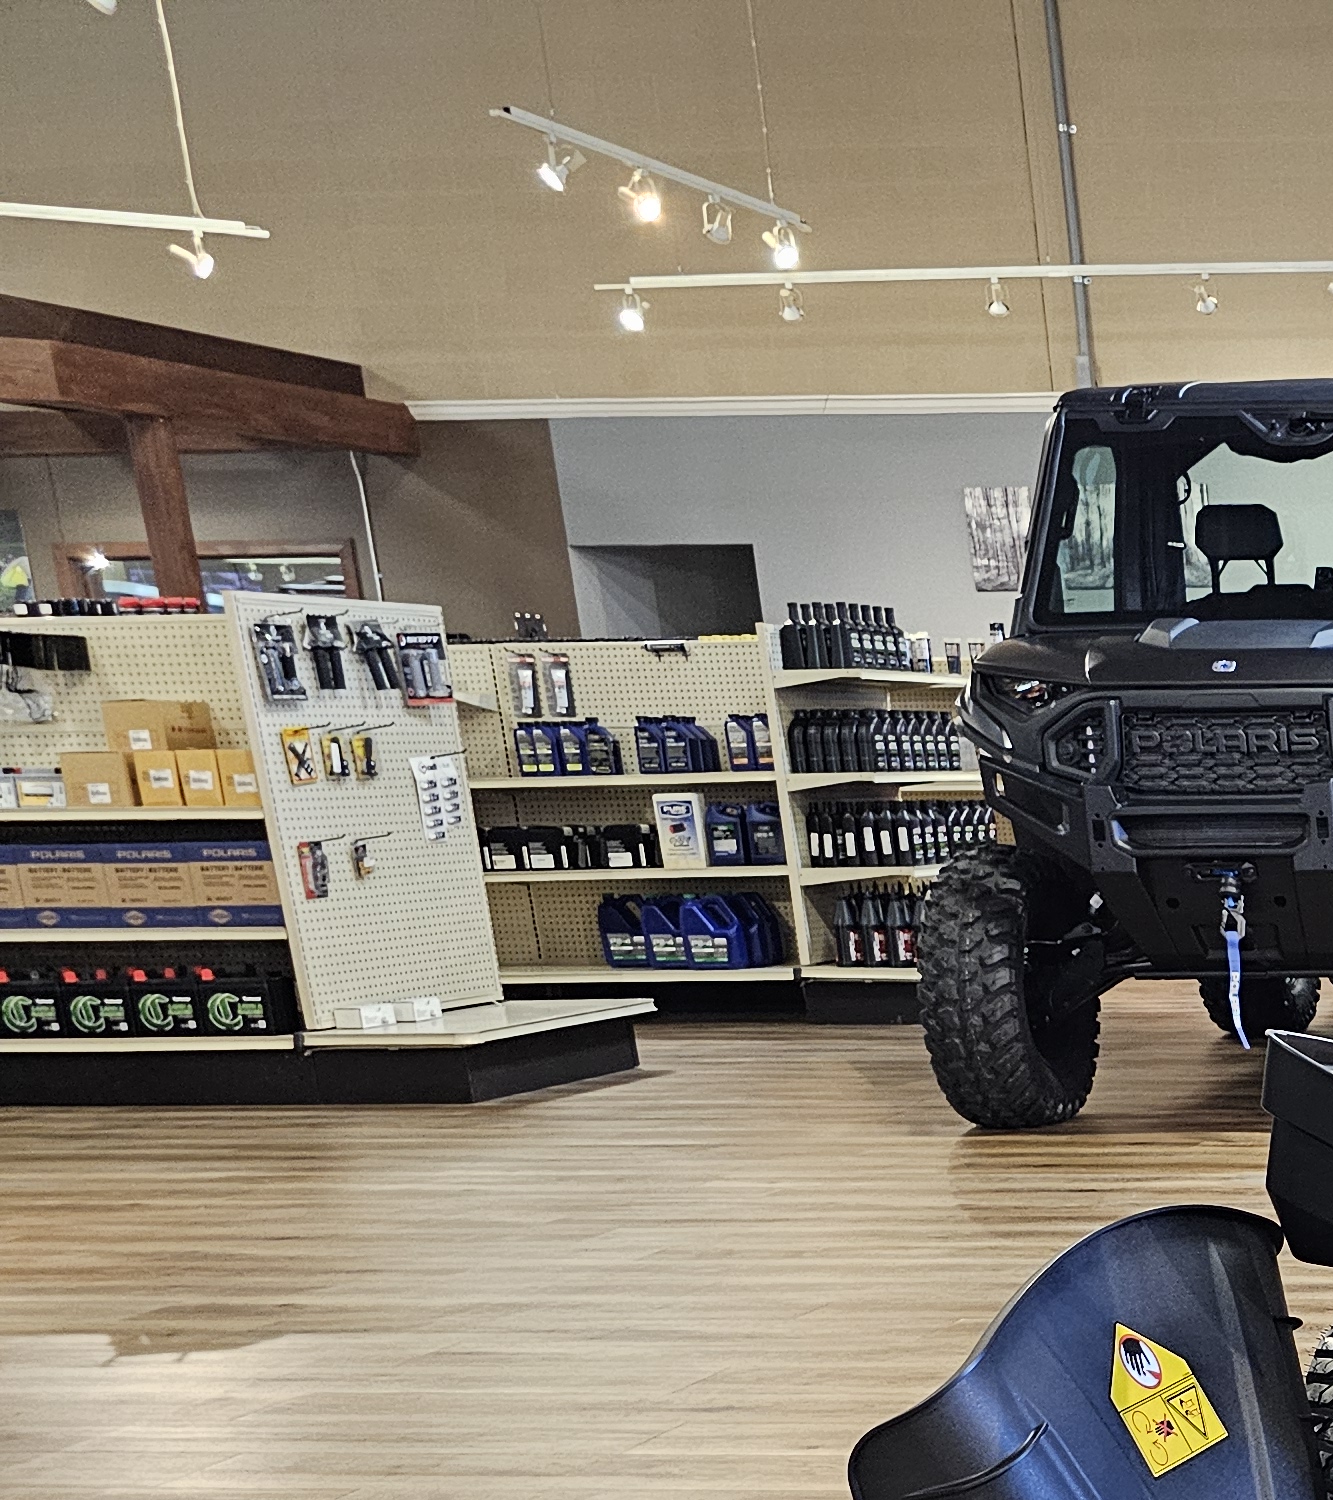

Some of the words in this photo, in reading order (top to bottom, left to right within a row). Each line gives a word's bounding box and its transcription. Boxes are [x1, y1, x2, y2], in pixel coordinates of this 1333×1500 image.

[1131, 727, 1320, 754] POLARIS
[31, 850, 85, 859] POLARIS
[116, 850, 172, 860] POLARIS
[202, 848, 257, 858] POLARIS
